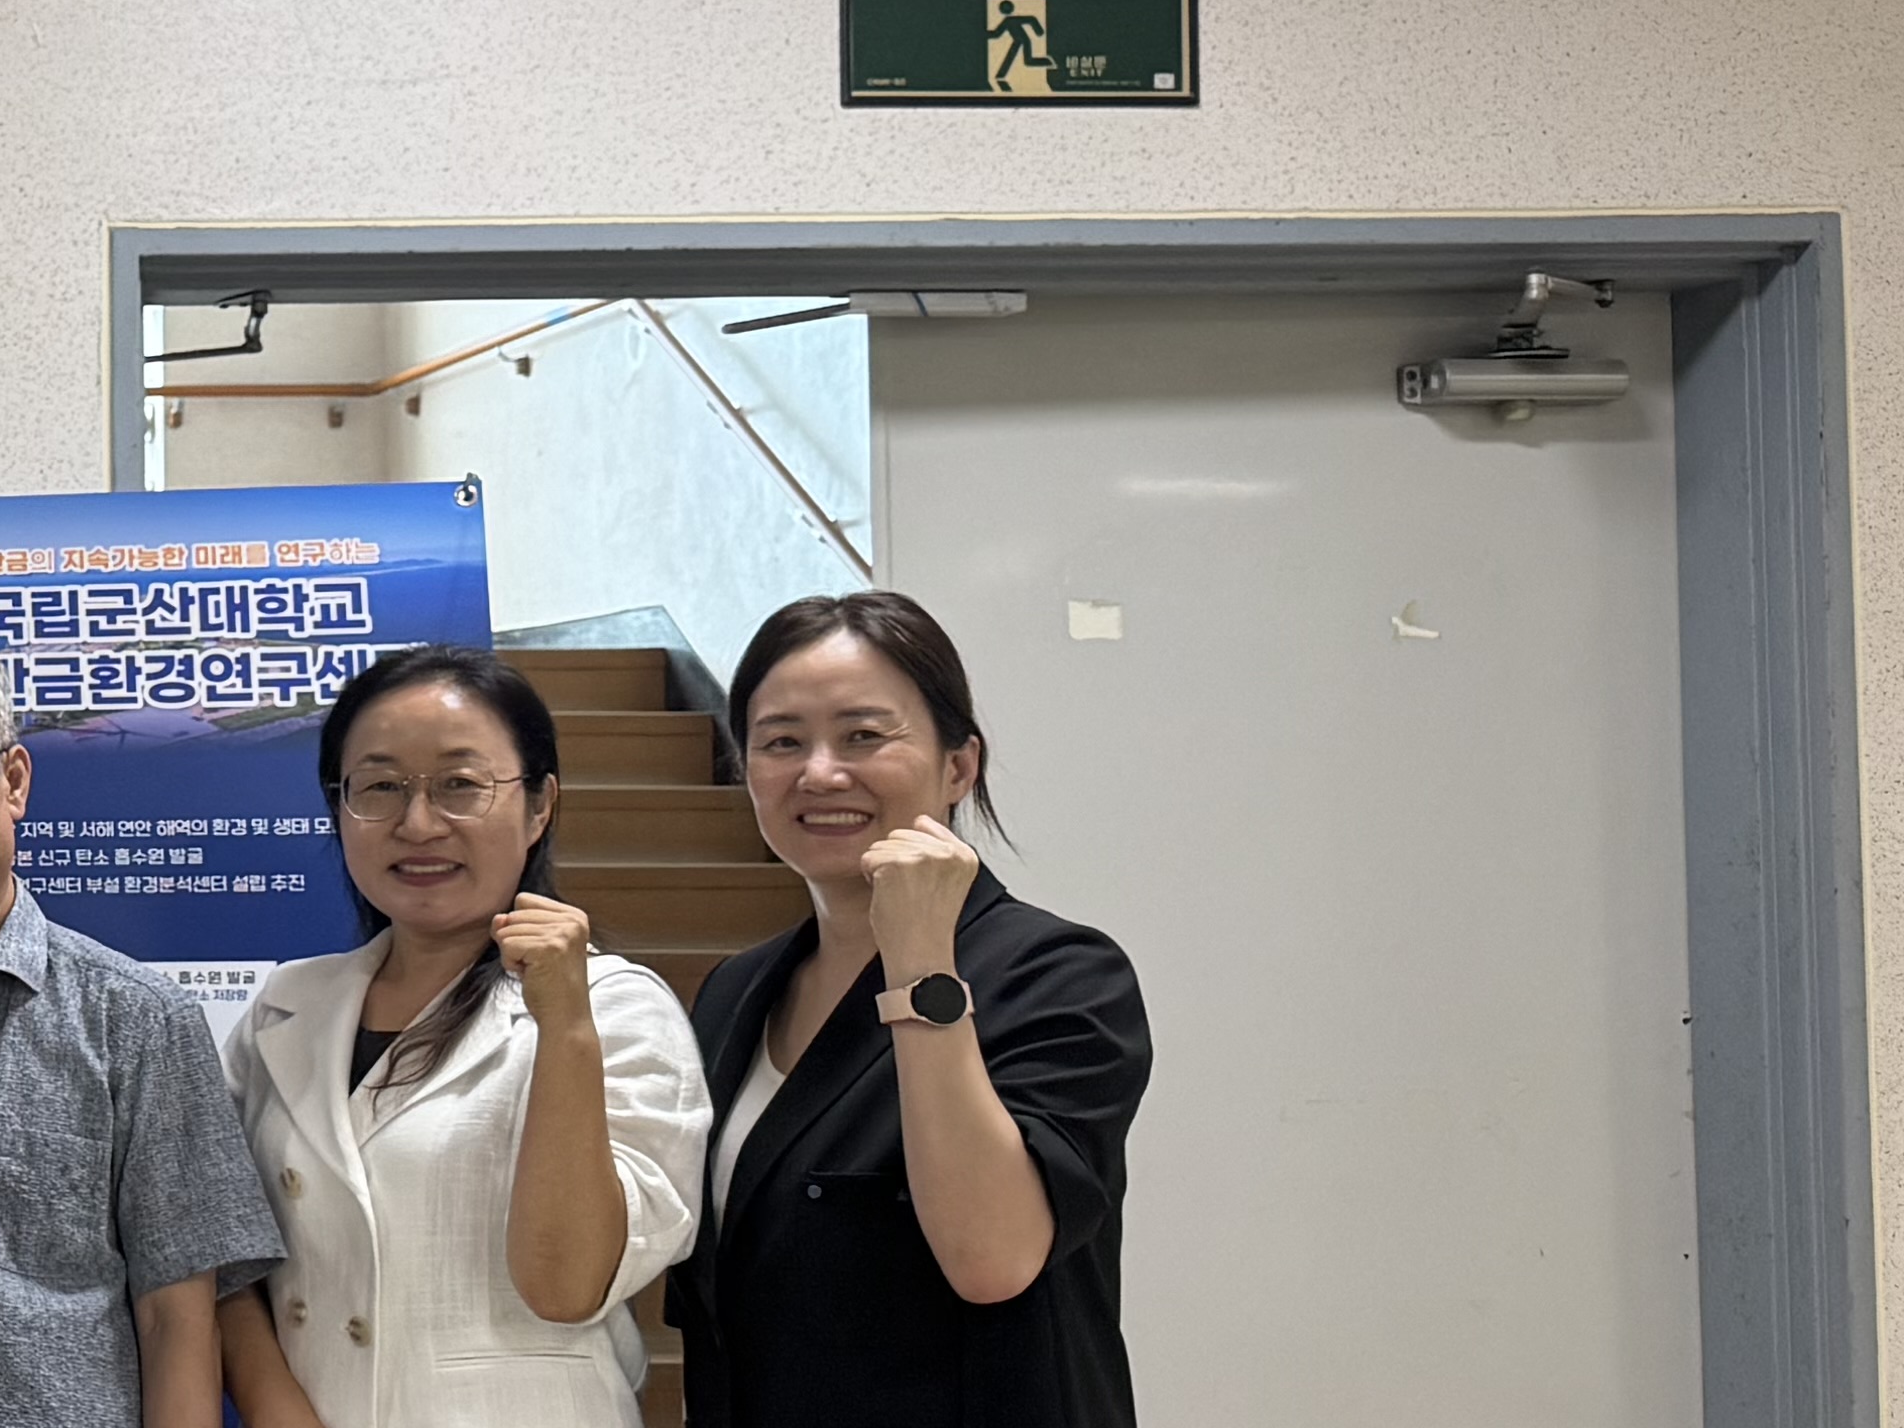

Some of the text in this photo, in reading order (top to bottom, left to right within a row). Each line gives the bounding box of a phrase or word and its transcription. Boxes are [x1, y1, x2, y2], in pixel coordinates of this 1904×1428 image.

[62, 546, 186, 571] 지속가능한
[277, 539, 378, 565] 연구하는
[3, 647, 374, 708] 금환경연구센
[20, 817, 336, 838] 지역 및 서해 연안 해역의 환경 및 생태 모
[38, 849, 71, 866] 신규
[75, 848, 109, 866] 탄소
[124, 875, 227, 893] 환경분석센터
[271, 874, 305, 892] 추진
